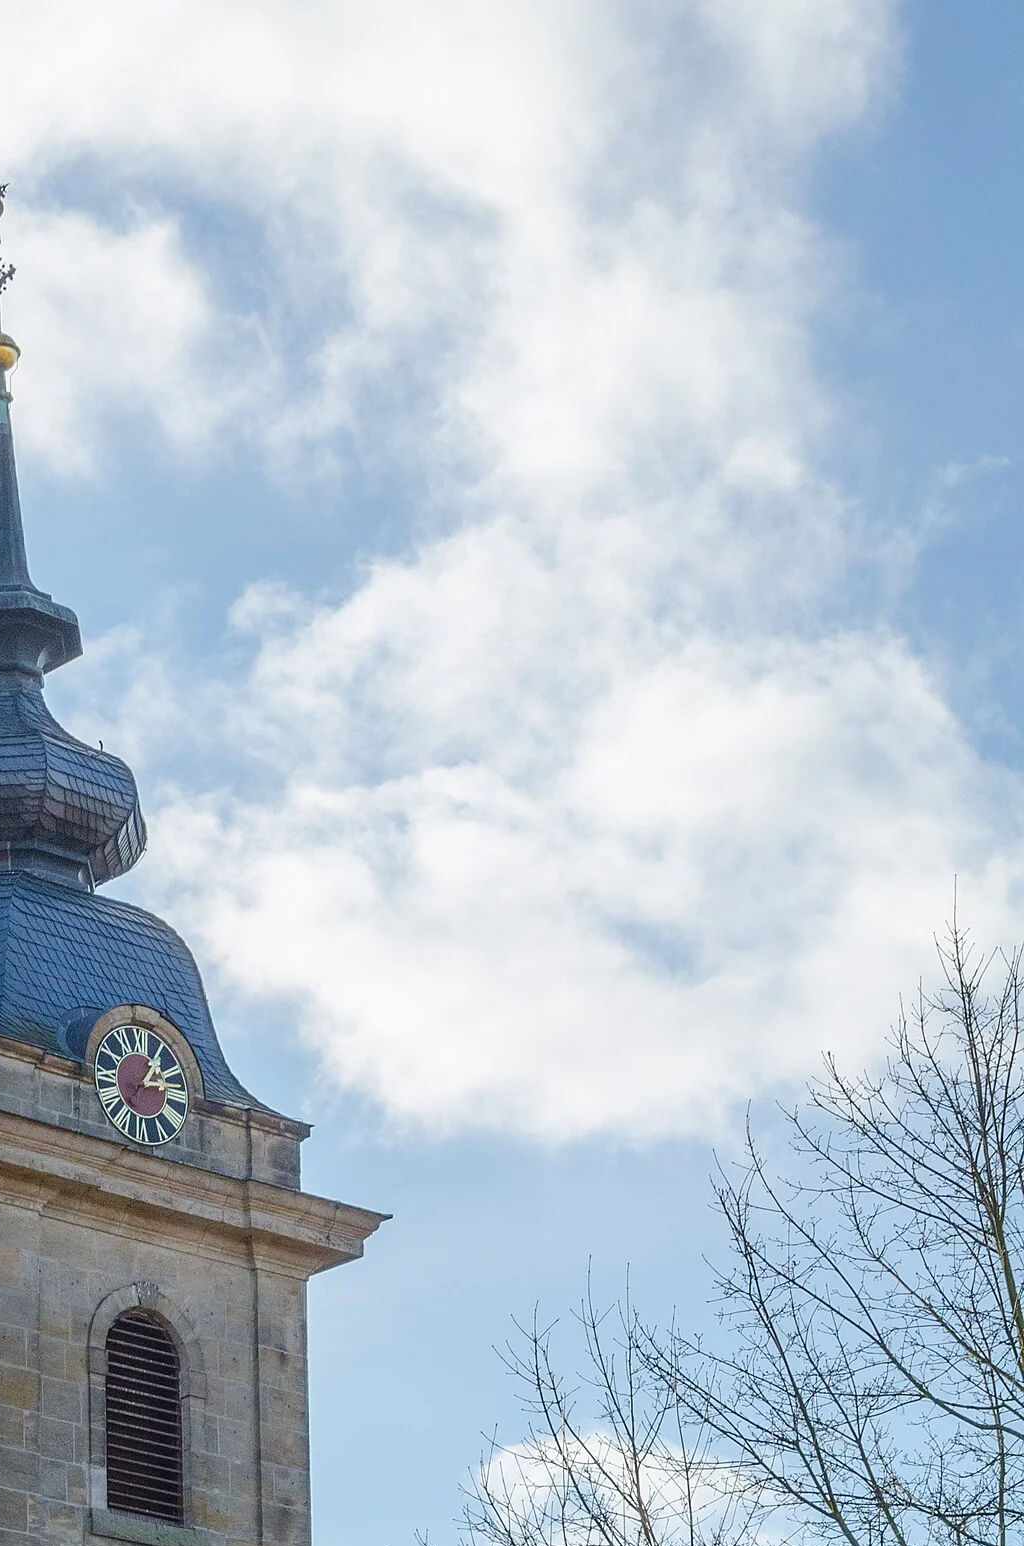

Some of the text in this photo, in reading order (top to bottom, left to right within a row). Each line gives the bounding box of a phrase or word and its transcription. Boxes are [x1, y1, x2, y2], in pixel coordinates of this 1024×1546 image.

[100, 1042, 121, 1064] X
[162, 1064, 181, 1078] II
[155, 1117, 169, 1141] V
